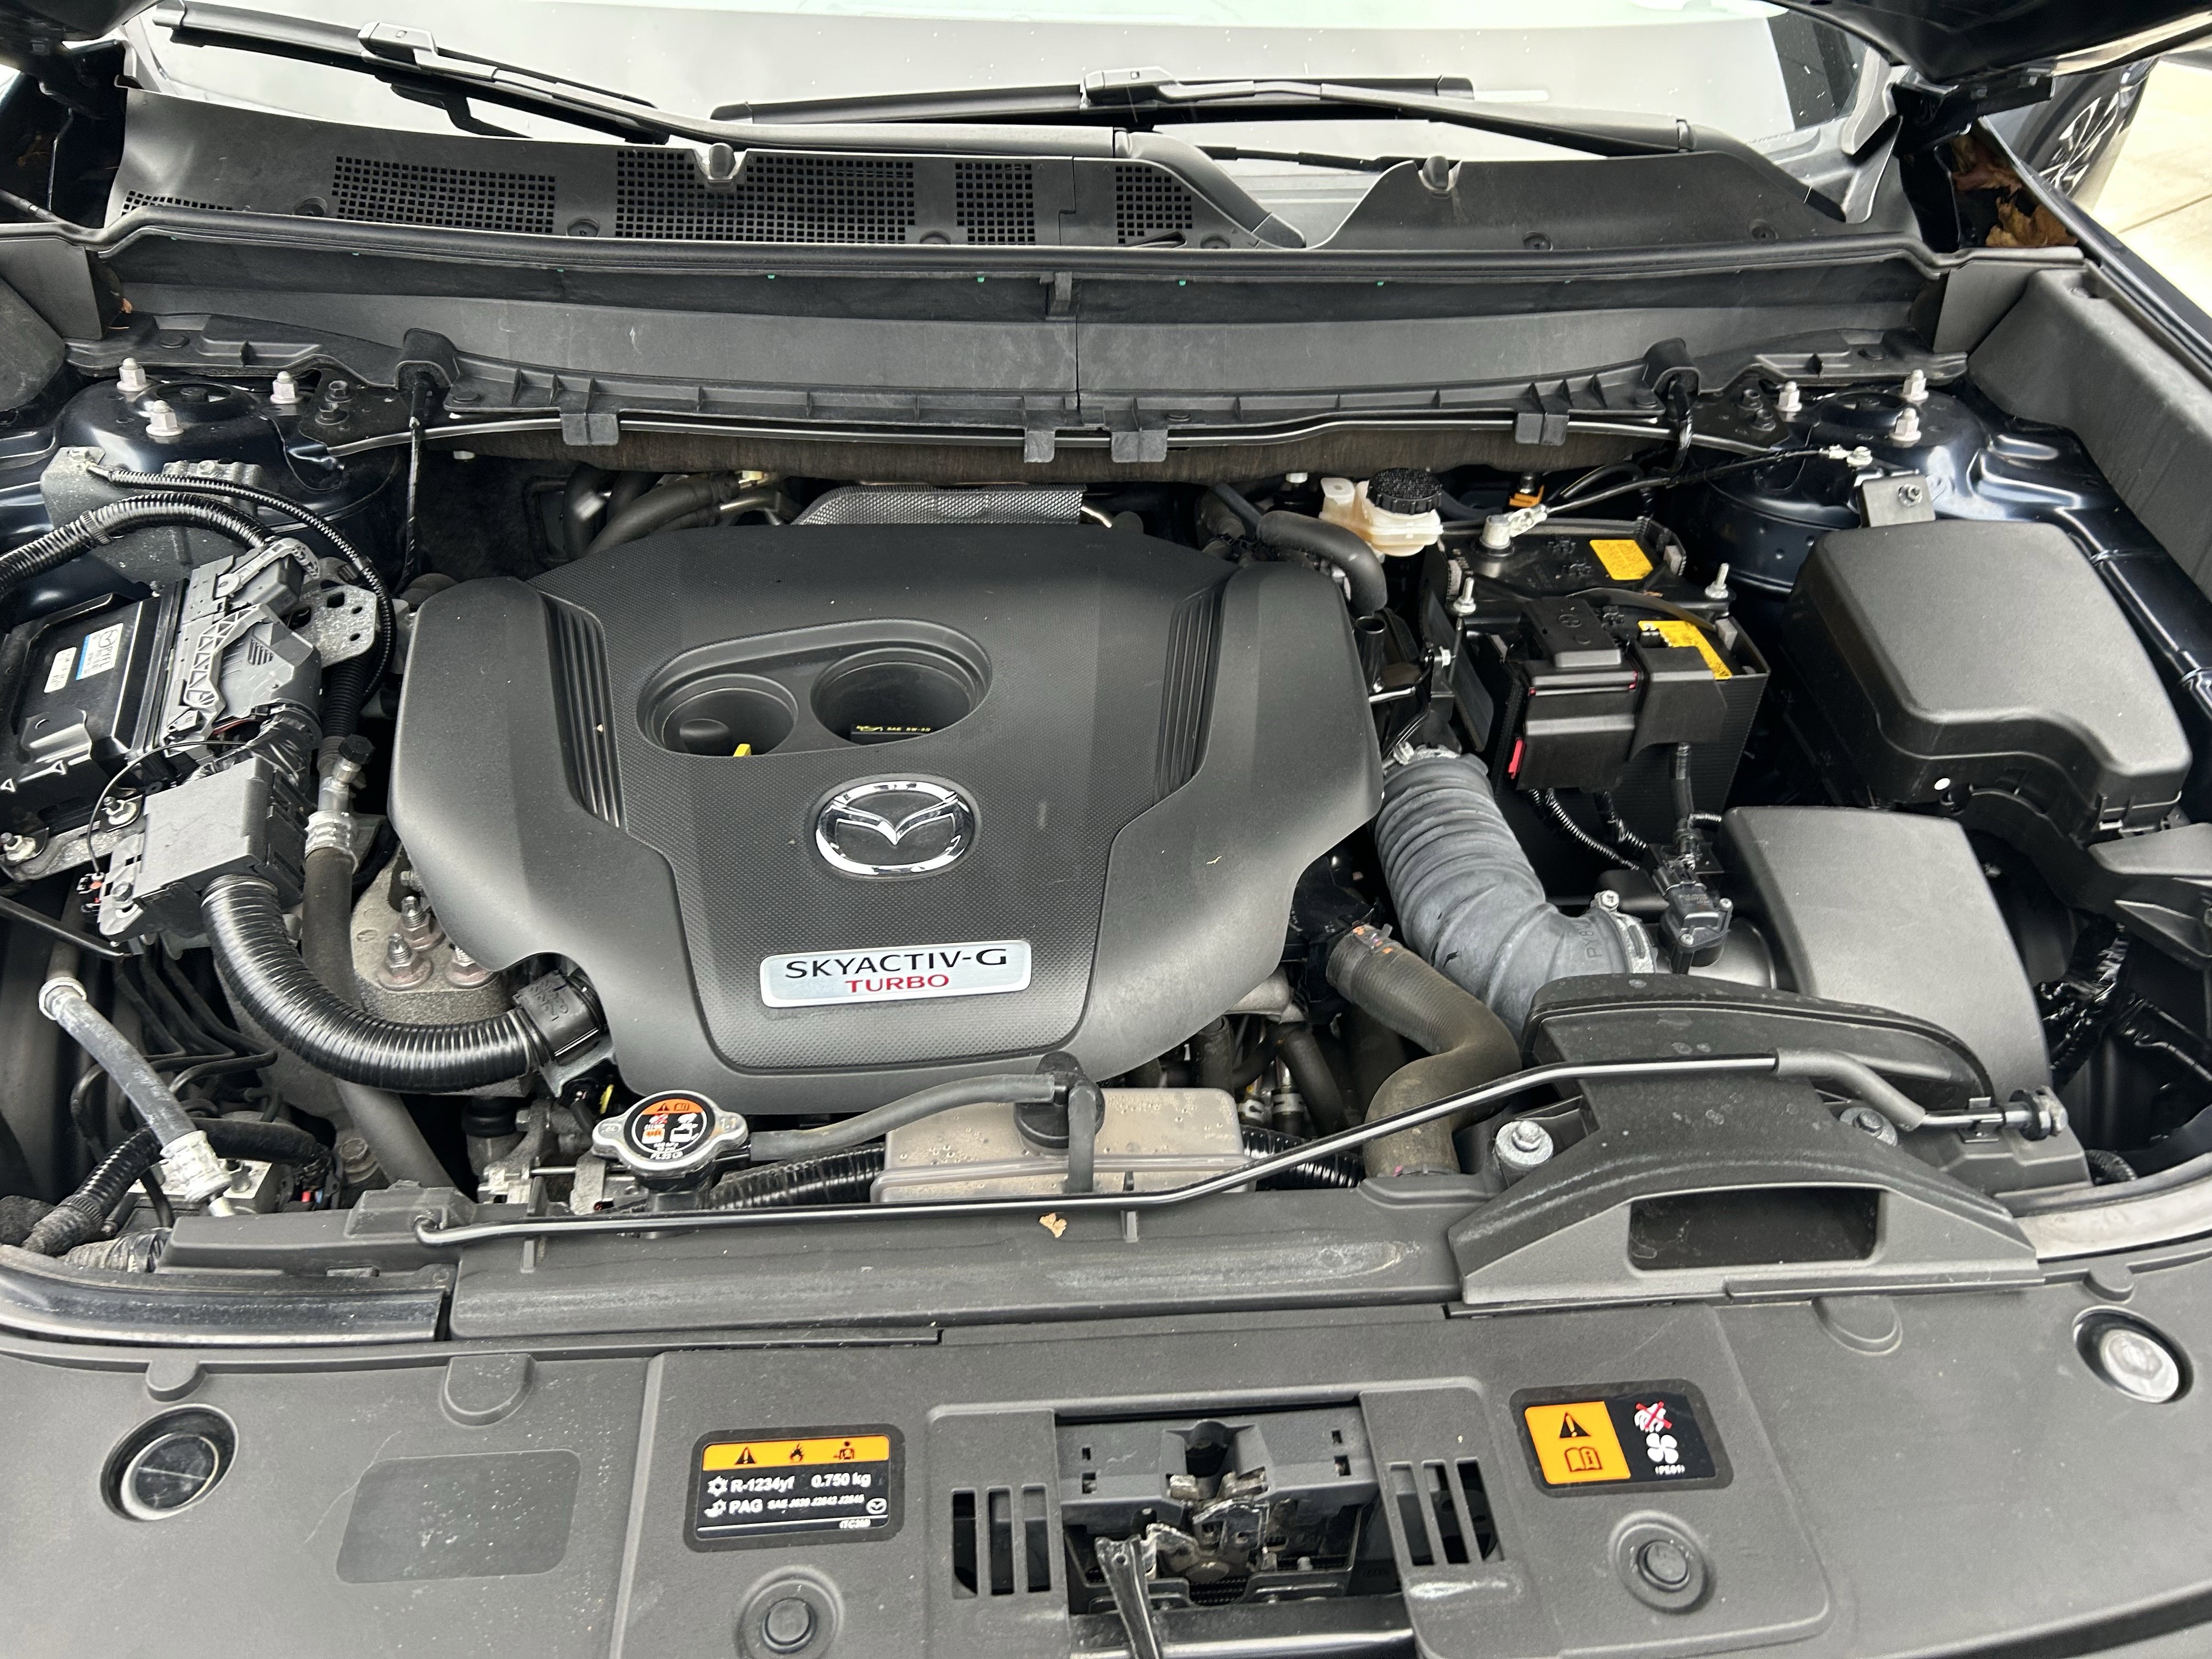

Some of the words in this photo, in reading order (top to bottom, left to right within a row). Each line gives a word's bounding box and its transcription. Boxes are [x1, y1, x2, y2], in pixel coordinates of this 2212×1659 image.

[785, 948, 1007, 979] SKYACTIV-G
[845, 974, 949, 993] TURBO
[730, 1476, 795, 1493] R-1234yf
[811, 1472, 850, 1488] 0.750
[853, 1472, 871, 1488] kg
[729, 1498, 763, 1514] PAG
